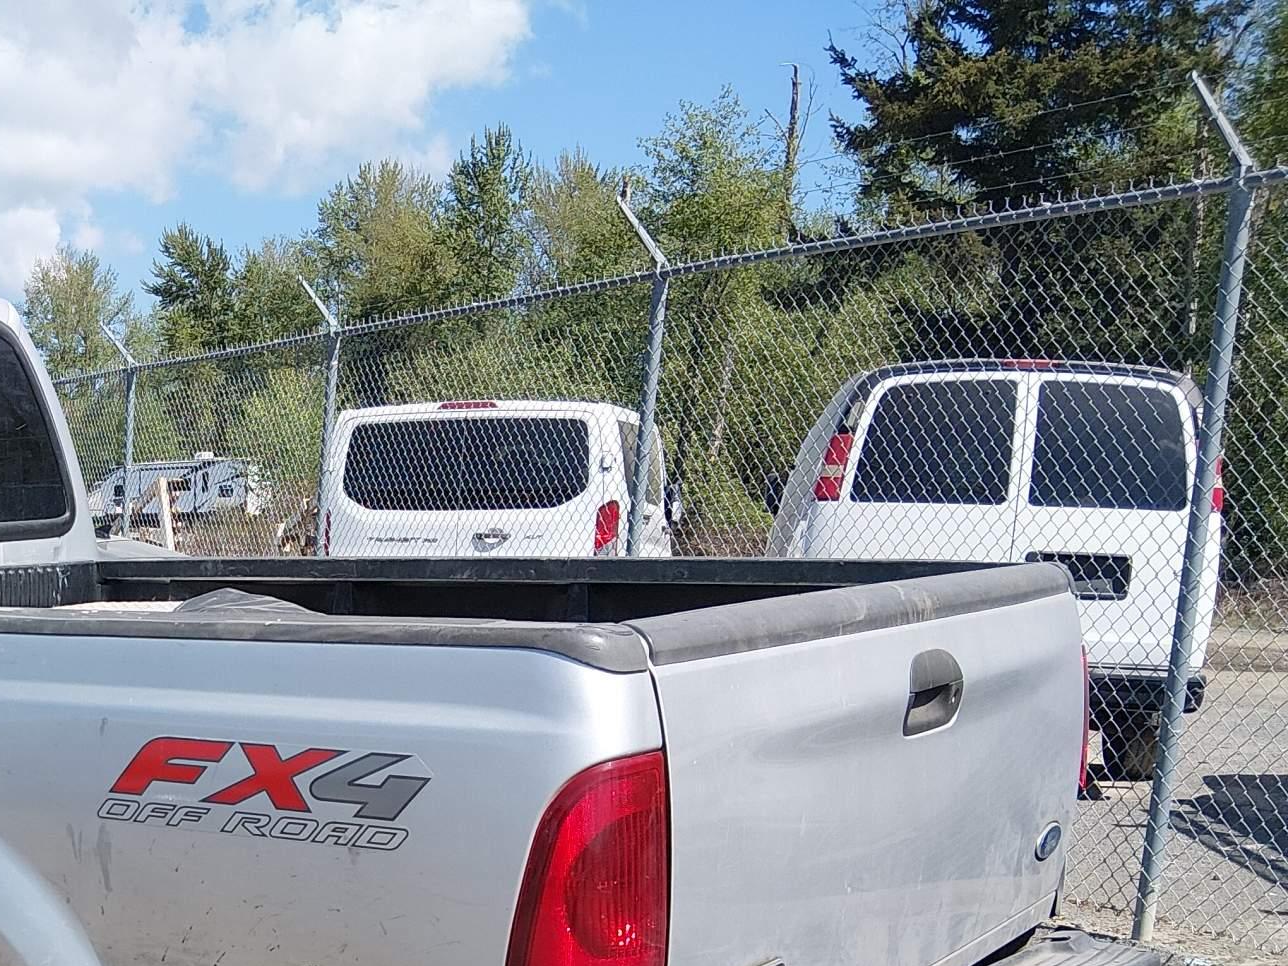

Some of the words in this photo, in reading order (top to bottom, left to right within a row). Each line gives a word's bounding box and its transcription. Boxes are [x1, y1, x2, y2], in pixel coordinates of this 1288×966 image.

[108, 736, 433, 821] FX4
[97, 798, 211, 827] OFF
[220, 811, 410, 851] ROAD
